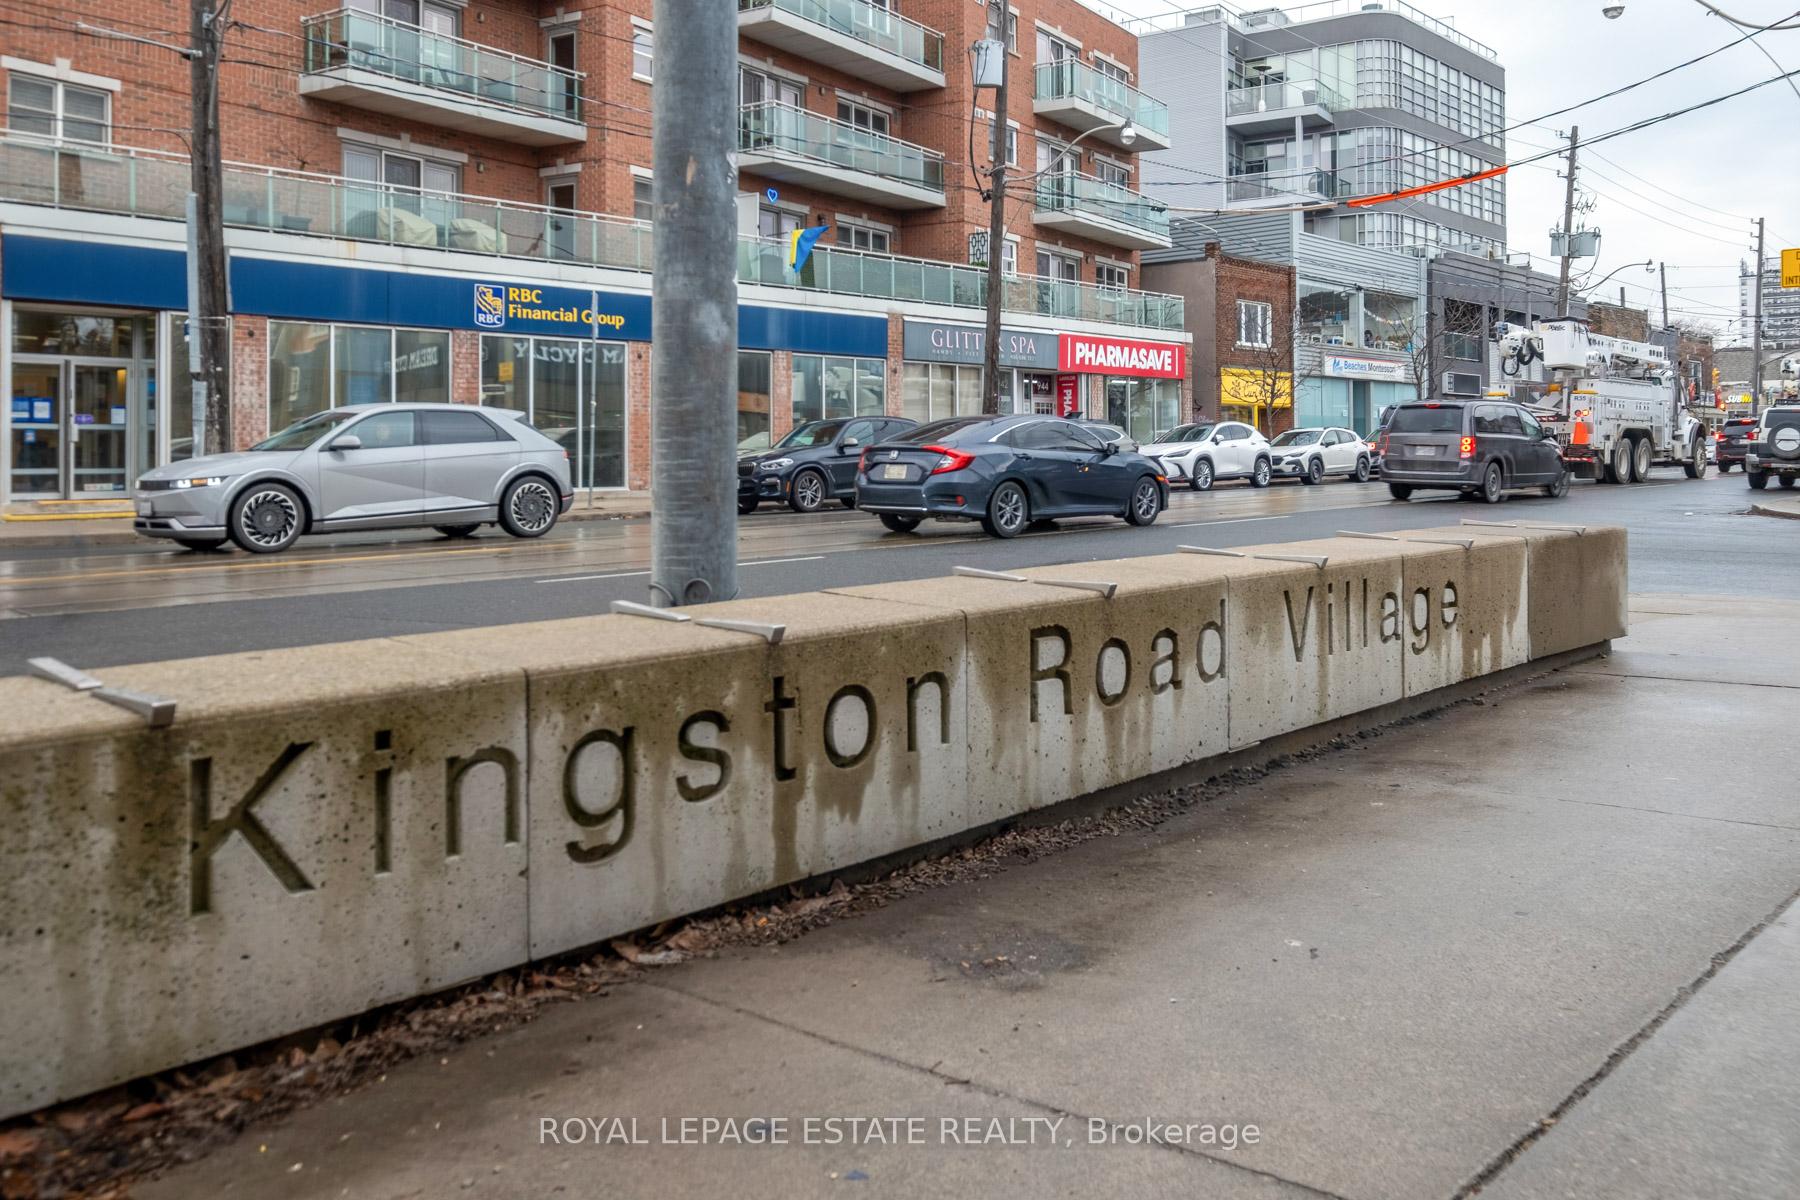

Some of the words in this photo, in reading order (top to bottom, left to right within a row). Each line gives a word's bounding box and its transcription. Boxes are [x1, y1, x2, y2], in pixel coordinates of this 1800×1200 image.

[509, 287, 542, 303] RBC
[478, 313, 501, 324] RBC
[509, 304, 578, 323] Financial
[581, 310, 625, 330] Goup
[931, 328, 1004, 351] GLITT
[1010, 336, 1036, 354] SPA
[1075, 342, 1172, 371] PHARMASAVE
[1344, 360, 1367, 371] Beaches
[1037, 380, 1049, 391] 944
[189, 671, 950, 915] Kingston
[1030, 597, 1227, 723] Road
[1283, 578, 1459, 662] Village
